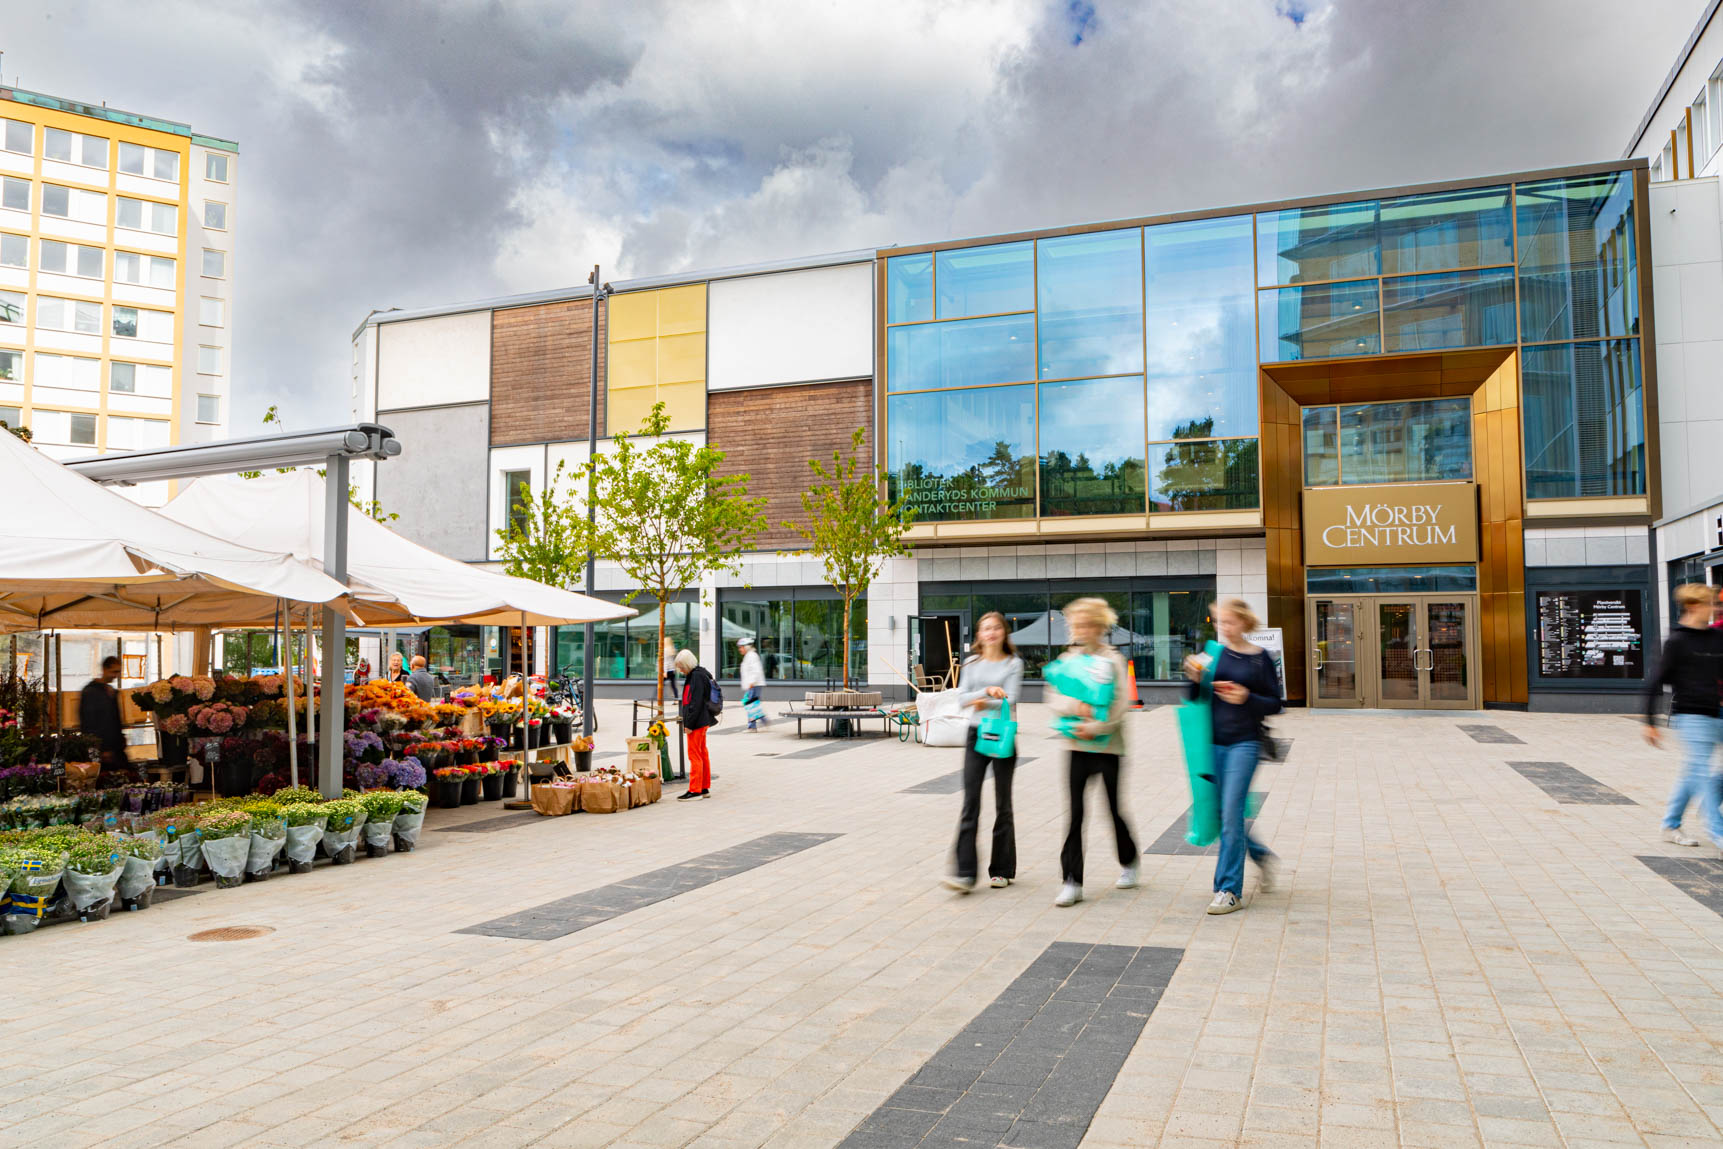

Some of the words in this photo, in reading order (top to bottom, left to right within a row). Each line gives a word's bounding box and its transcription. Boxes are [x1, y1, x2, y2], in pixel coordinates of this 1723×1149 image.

[898, 489, 967, 502] ANDERYDS
[970, 487, 1029, 499] KOMMUN
[1322, 525, 1457, 548] CENTRUM
